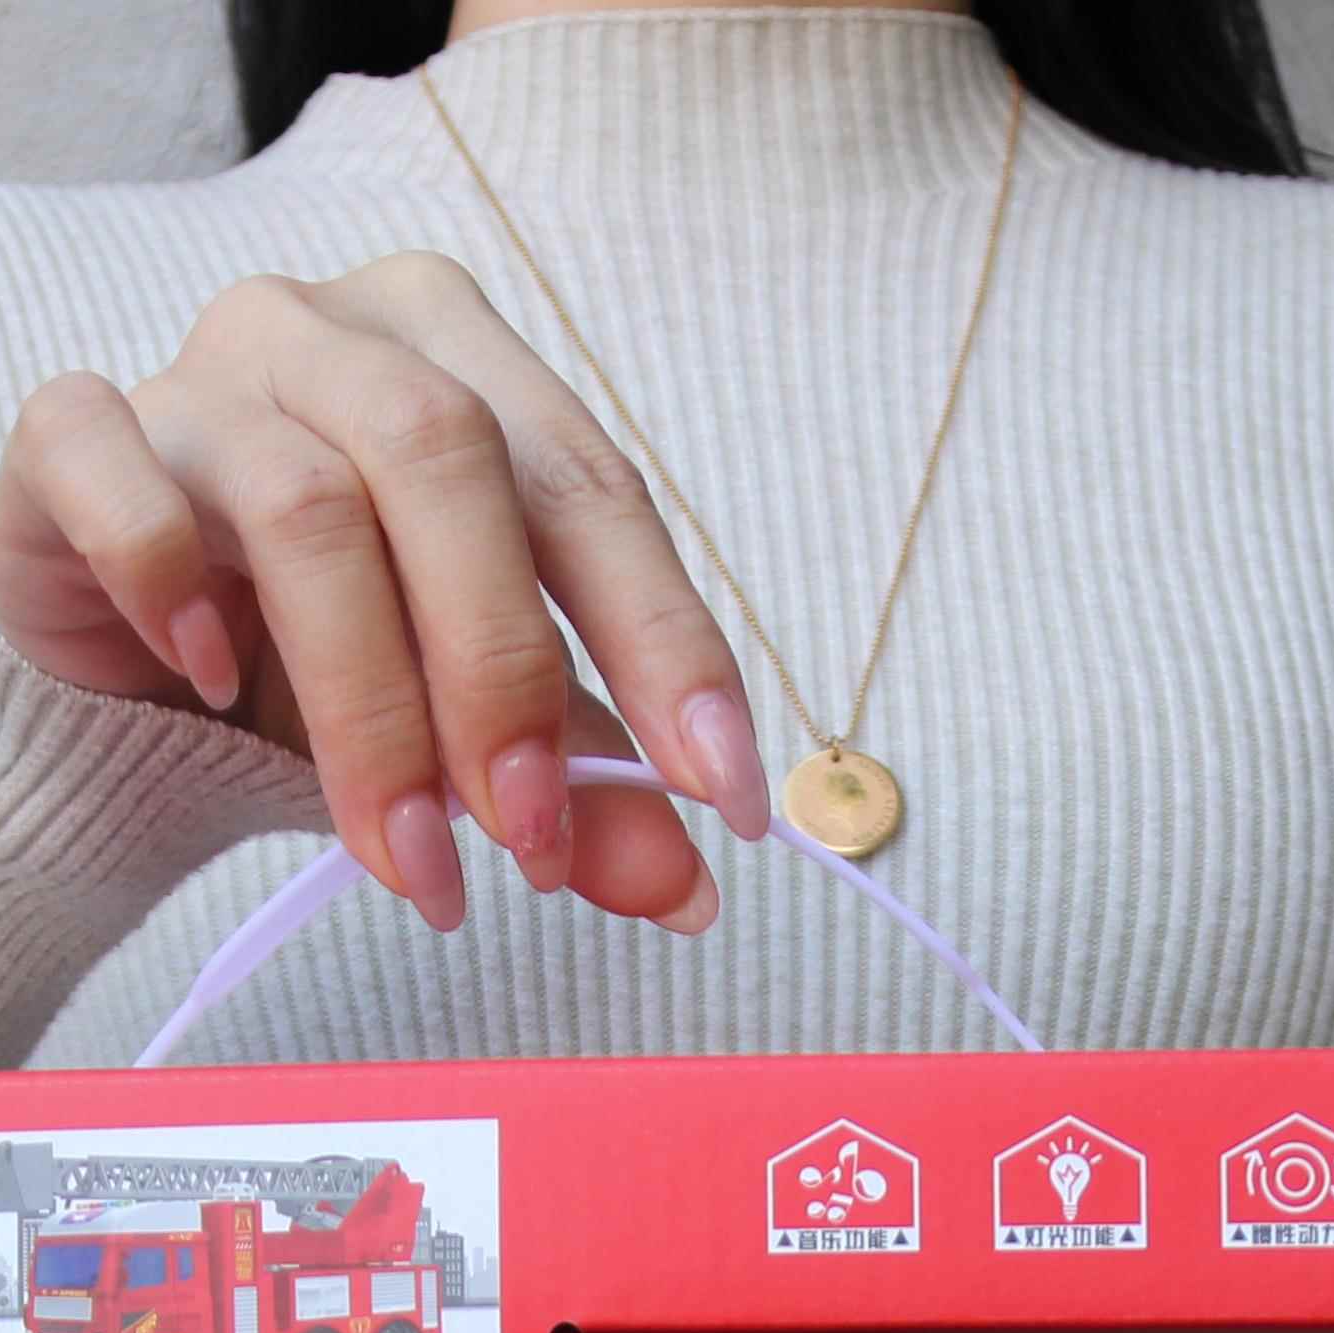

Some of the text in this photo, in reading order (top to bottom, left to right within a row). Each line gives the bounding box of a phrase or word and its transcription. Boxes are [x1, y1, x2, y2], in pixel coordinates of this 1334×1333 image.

[797, 1229, 889, 1250] 音乐功能
[1024, 1226, 1116, 1247] 灯光功能
